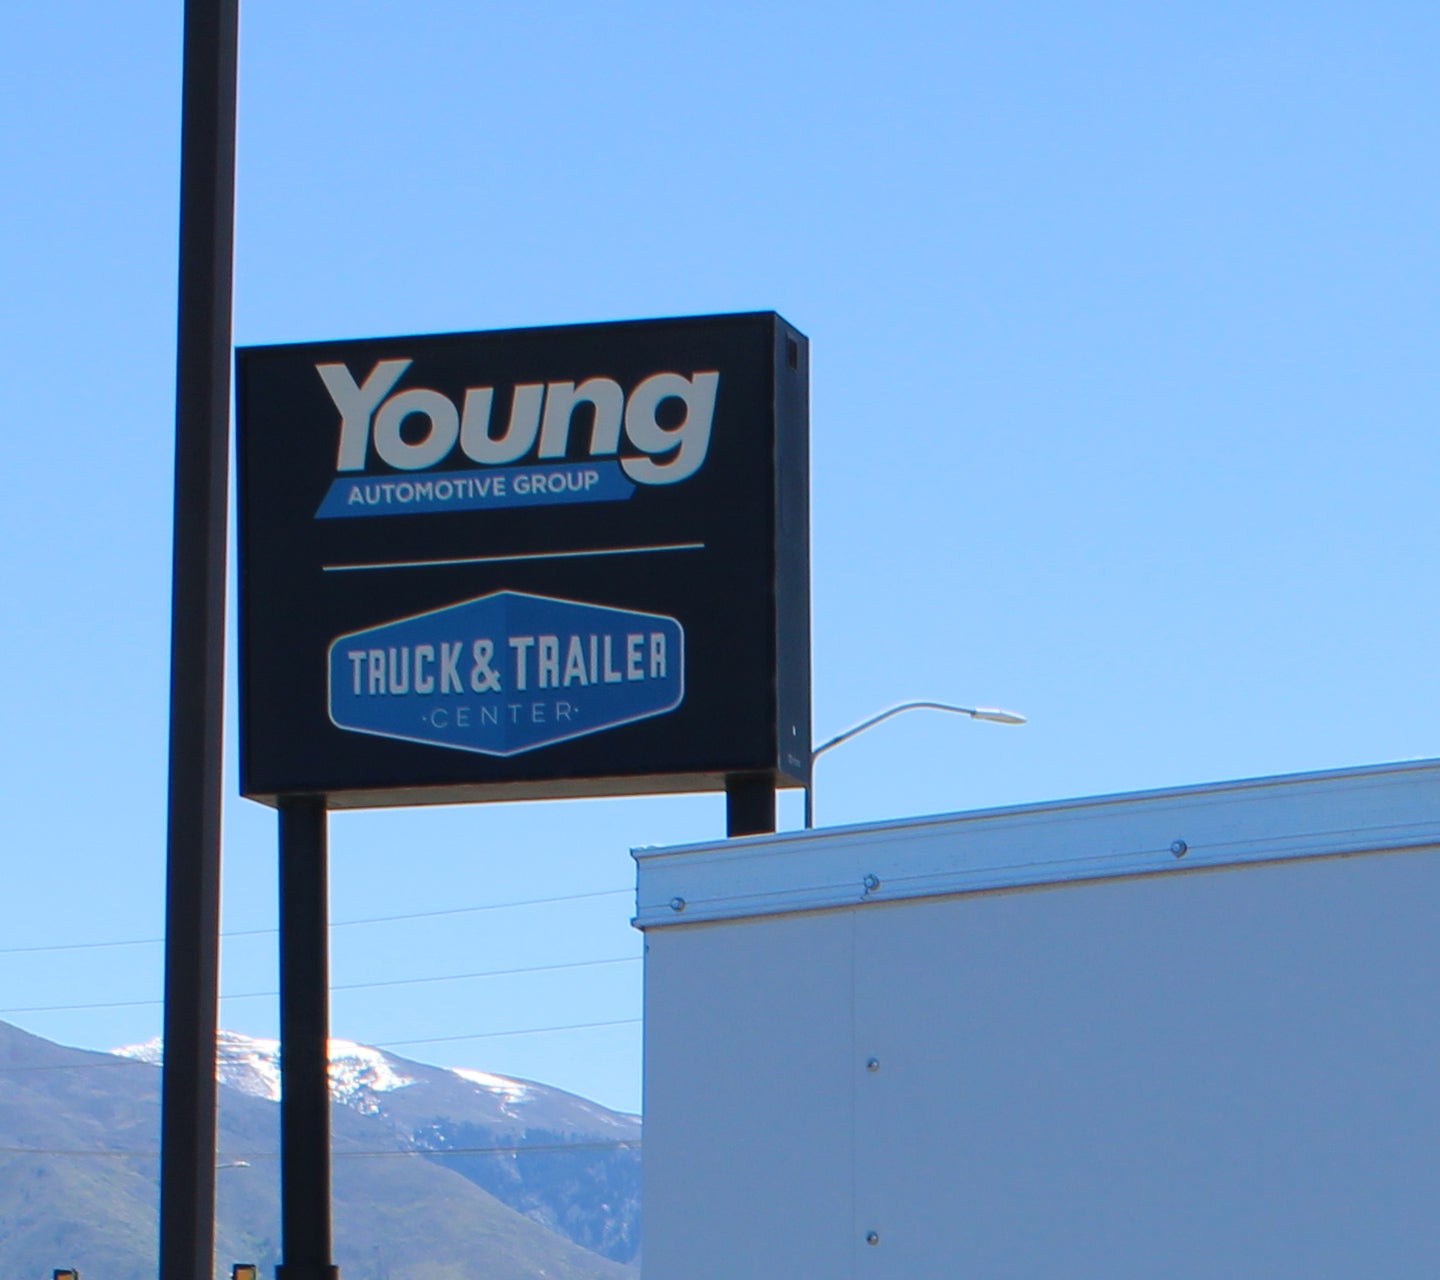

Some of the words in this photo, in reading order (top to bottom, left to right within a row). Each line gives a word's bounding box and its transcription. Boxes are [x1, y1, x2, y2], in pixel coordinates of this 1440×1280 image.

[314, 358, 720, 485] Young
[348, 476, 506, 505] AUTOMOTIVE
[513, 471, 599, 495] GROUP
[348, 641, 464, 696] TRUCK
[470, 639, 502, 695] &
[509, 632, 667, 691] TRAILER
[430, 701, 572, 729] CENTER
